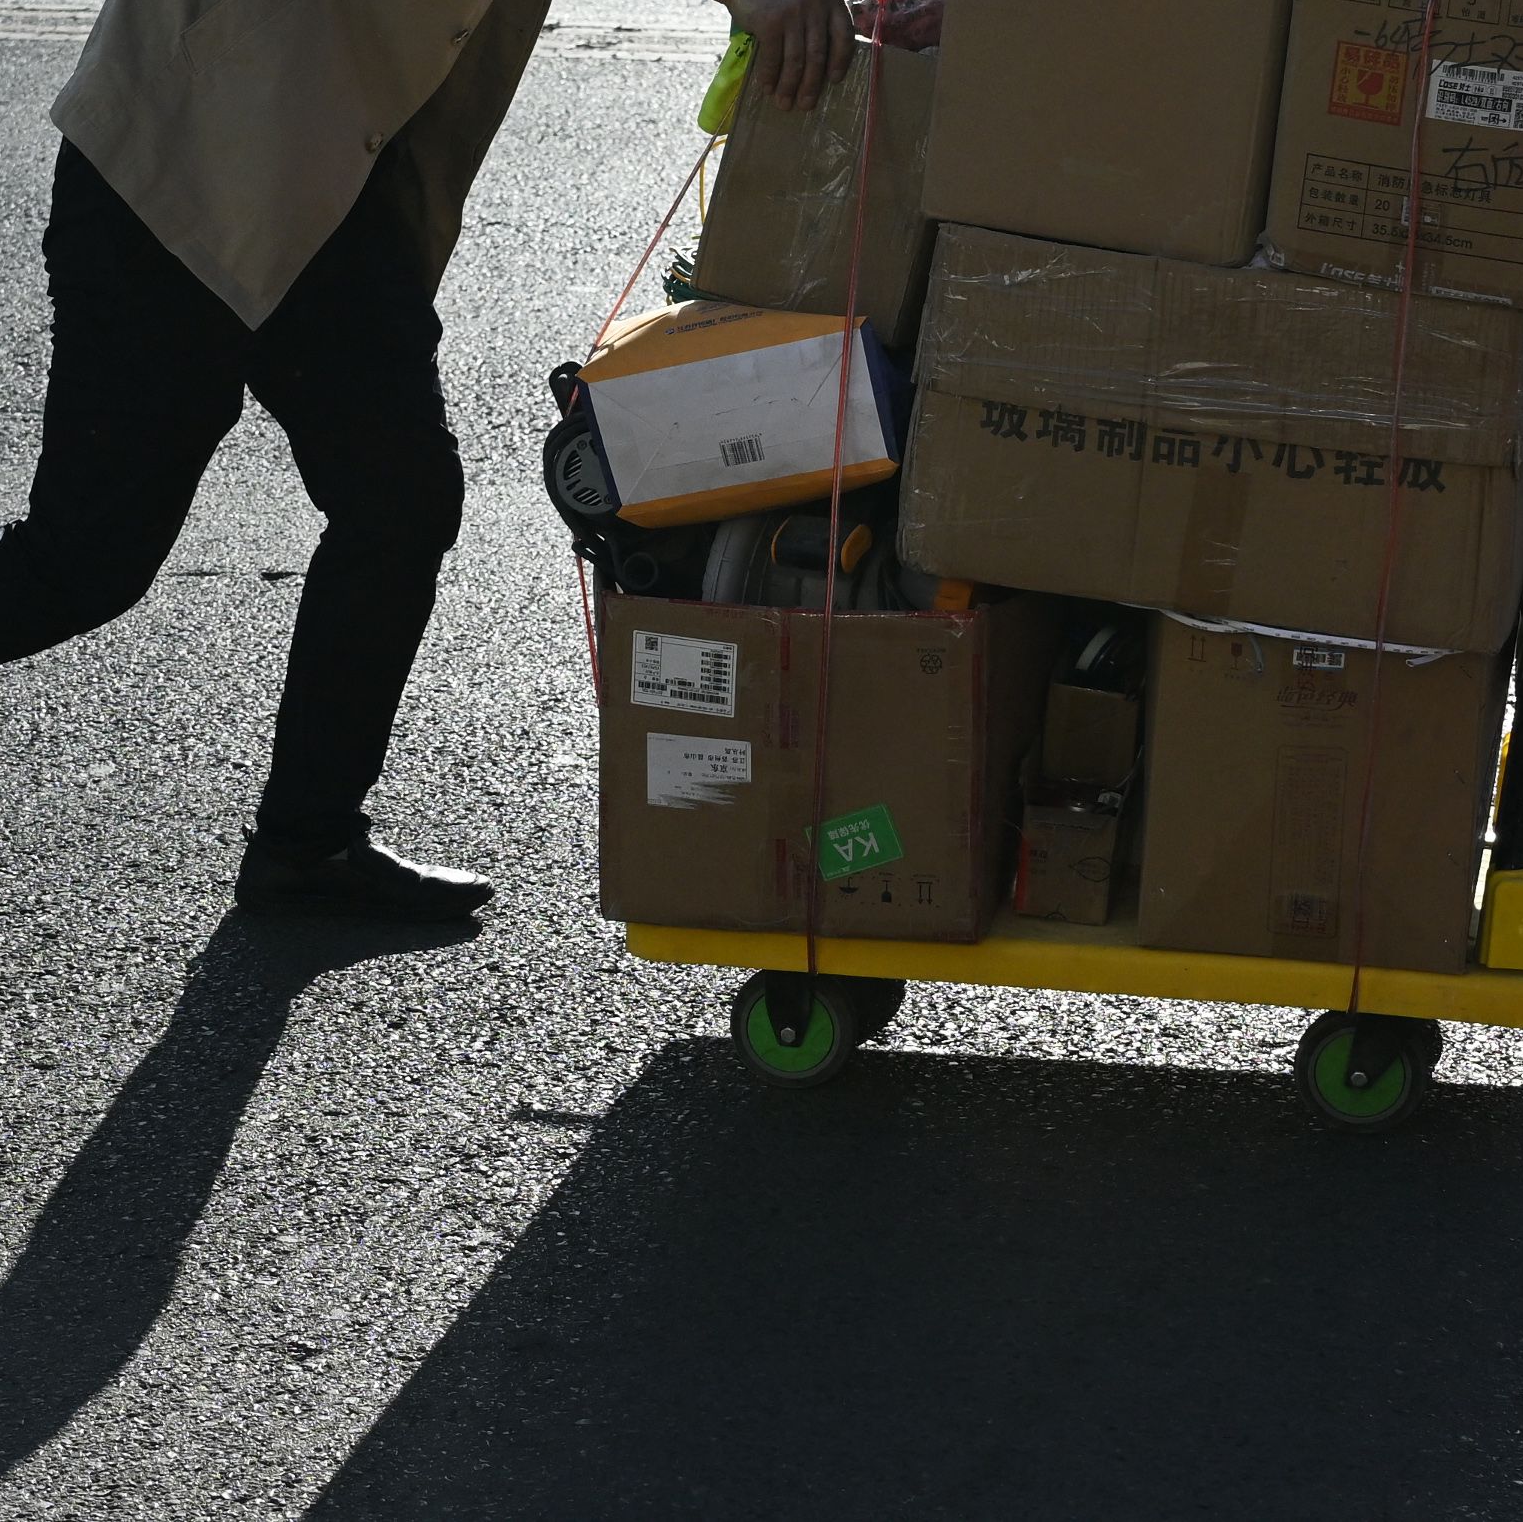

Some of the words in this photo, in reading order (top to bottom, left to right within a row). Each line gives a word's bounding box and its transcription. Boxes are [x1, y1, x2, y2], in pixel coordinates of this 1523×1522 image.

[1310, 162, 1362, 182] 产品名称
[1308, 186, 1359, 207] 包装数量
[1374, 198, 1390, 211] 20
[1304, 212, 1356, 231] 外箱尺寸
[979, 400, 1446, 494] 玻璃制品小心轻放
[832, 831, 880, 862] KA
